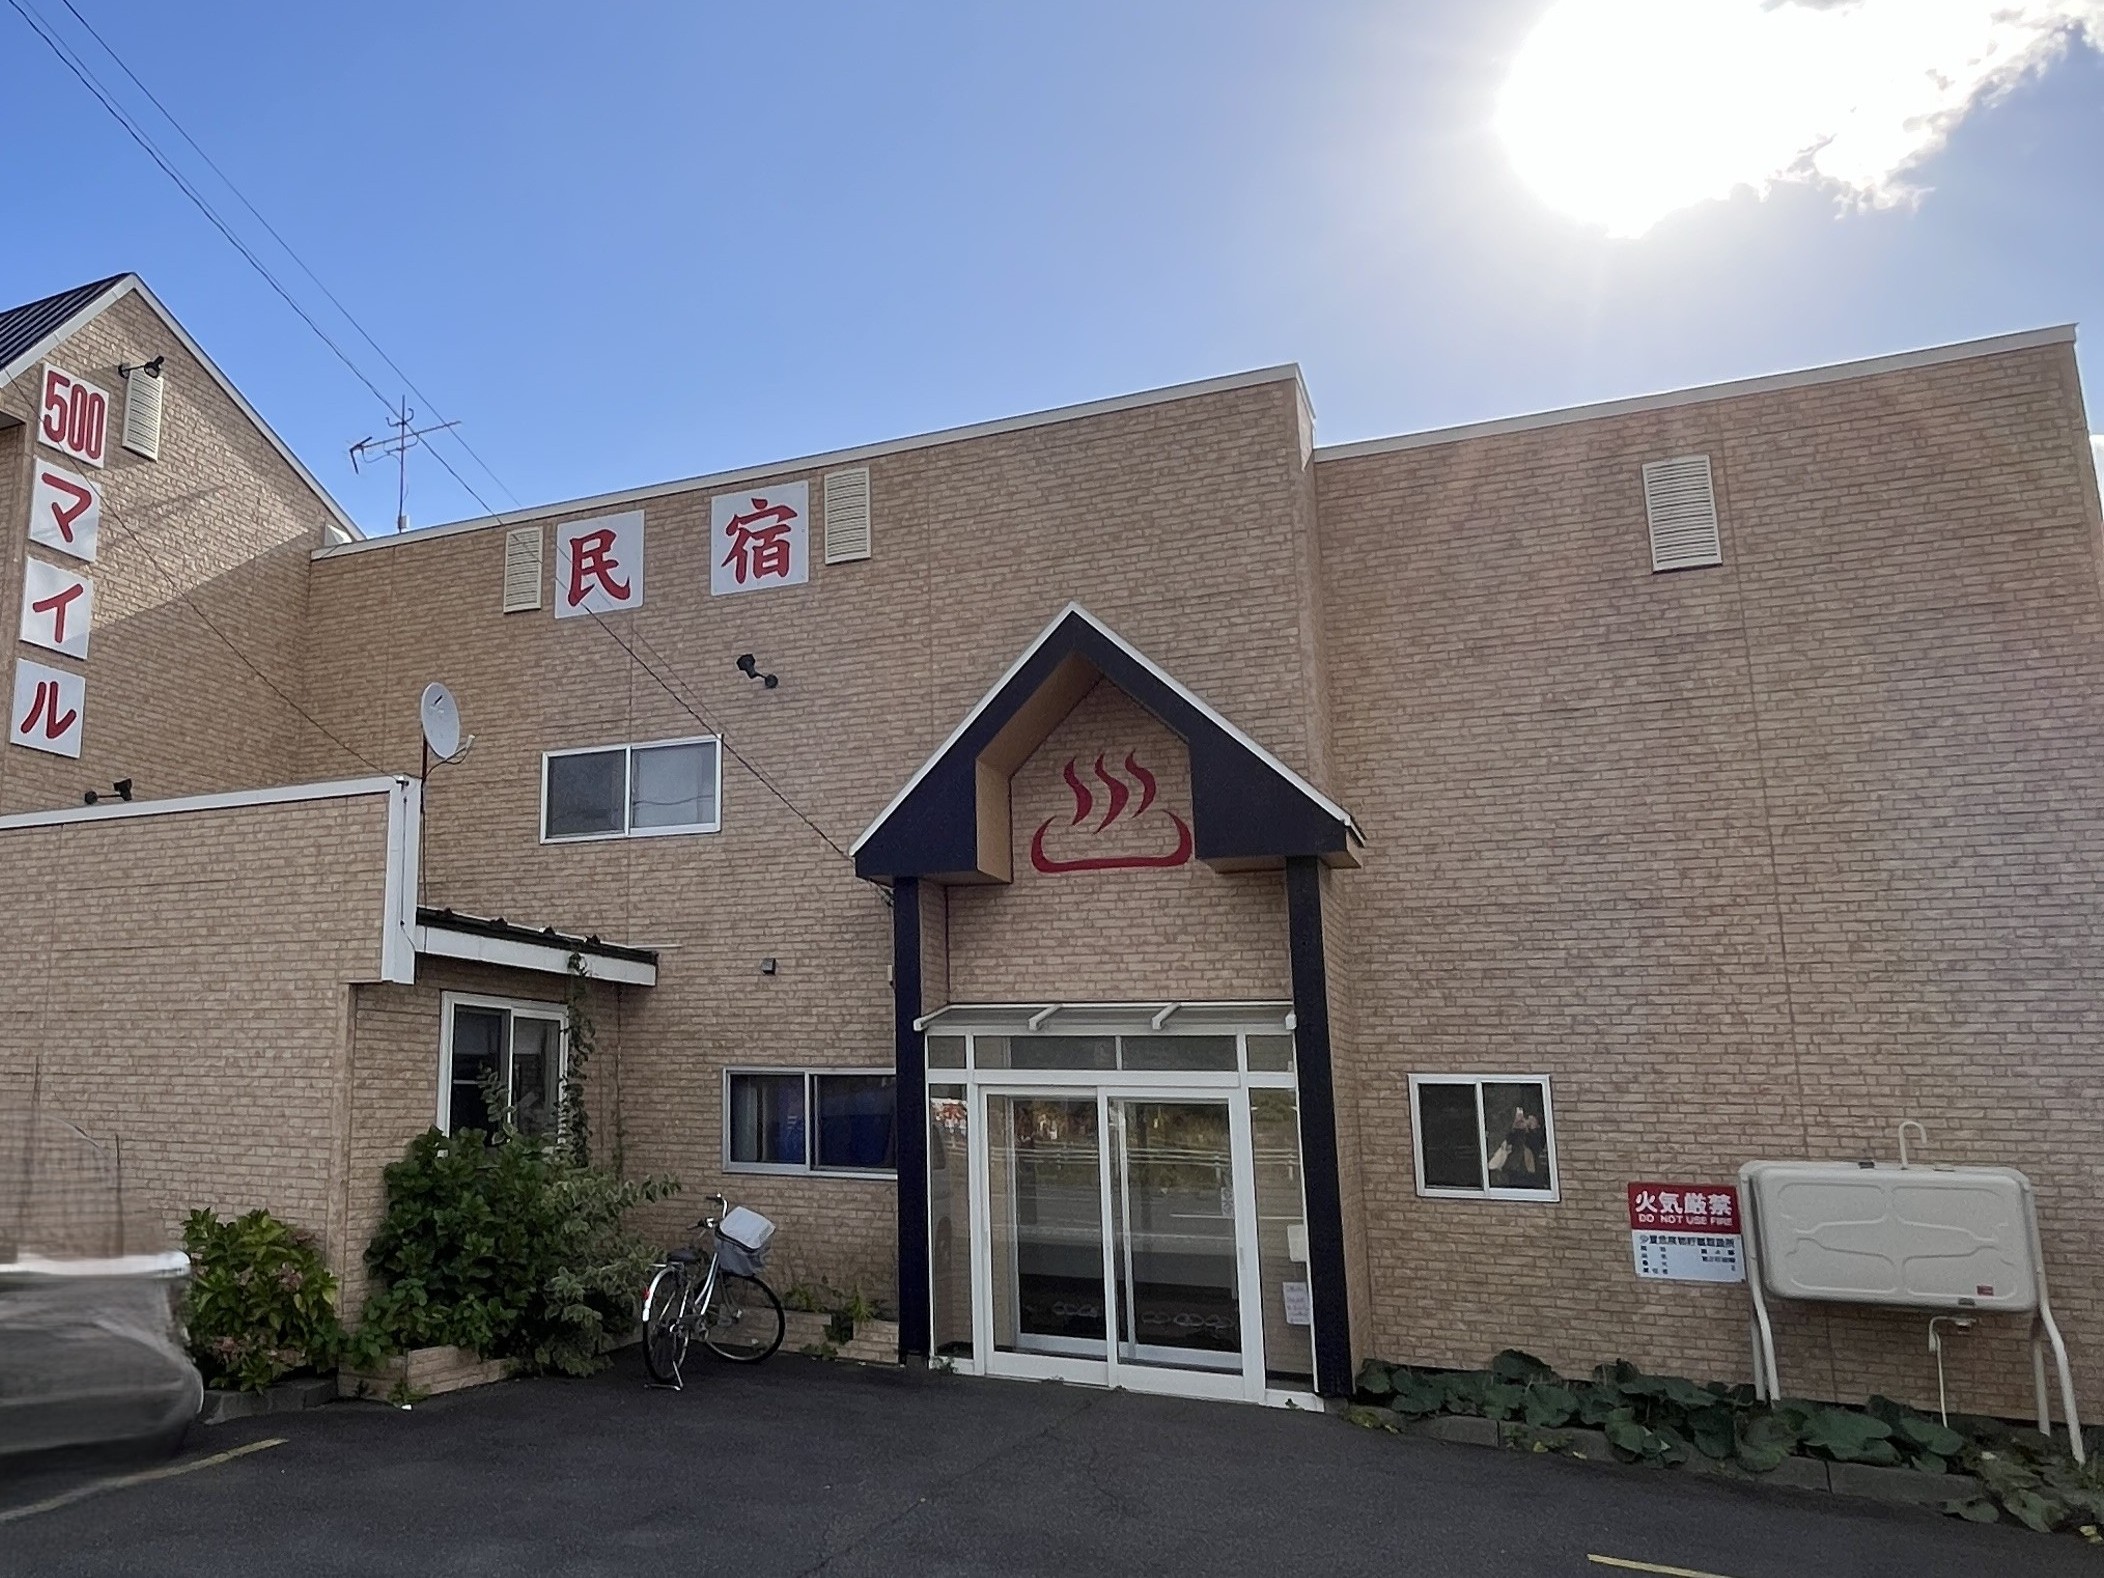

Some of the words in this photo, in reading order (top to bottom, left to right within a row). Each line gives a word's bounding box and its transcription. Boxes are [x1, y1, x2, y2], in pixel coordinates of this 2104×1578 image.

[43, 370, 106, 460] 500
[1635, 1190, 1733, 1215] 火気厳禁
[1638, 1213, 1655, 1223] DO
[1660, 1214, 1683, 1224] NOT
[1685, 1215, 1707, 1226] USE
[1710, 1216, 1733, 1227] FIRE
